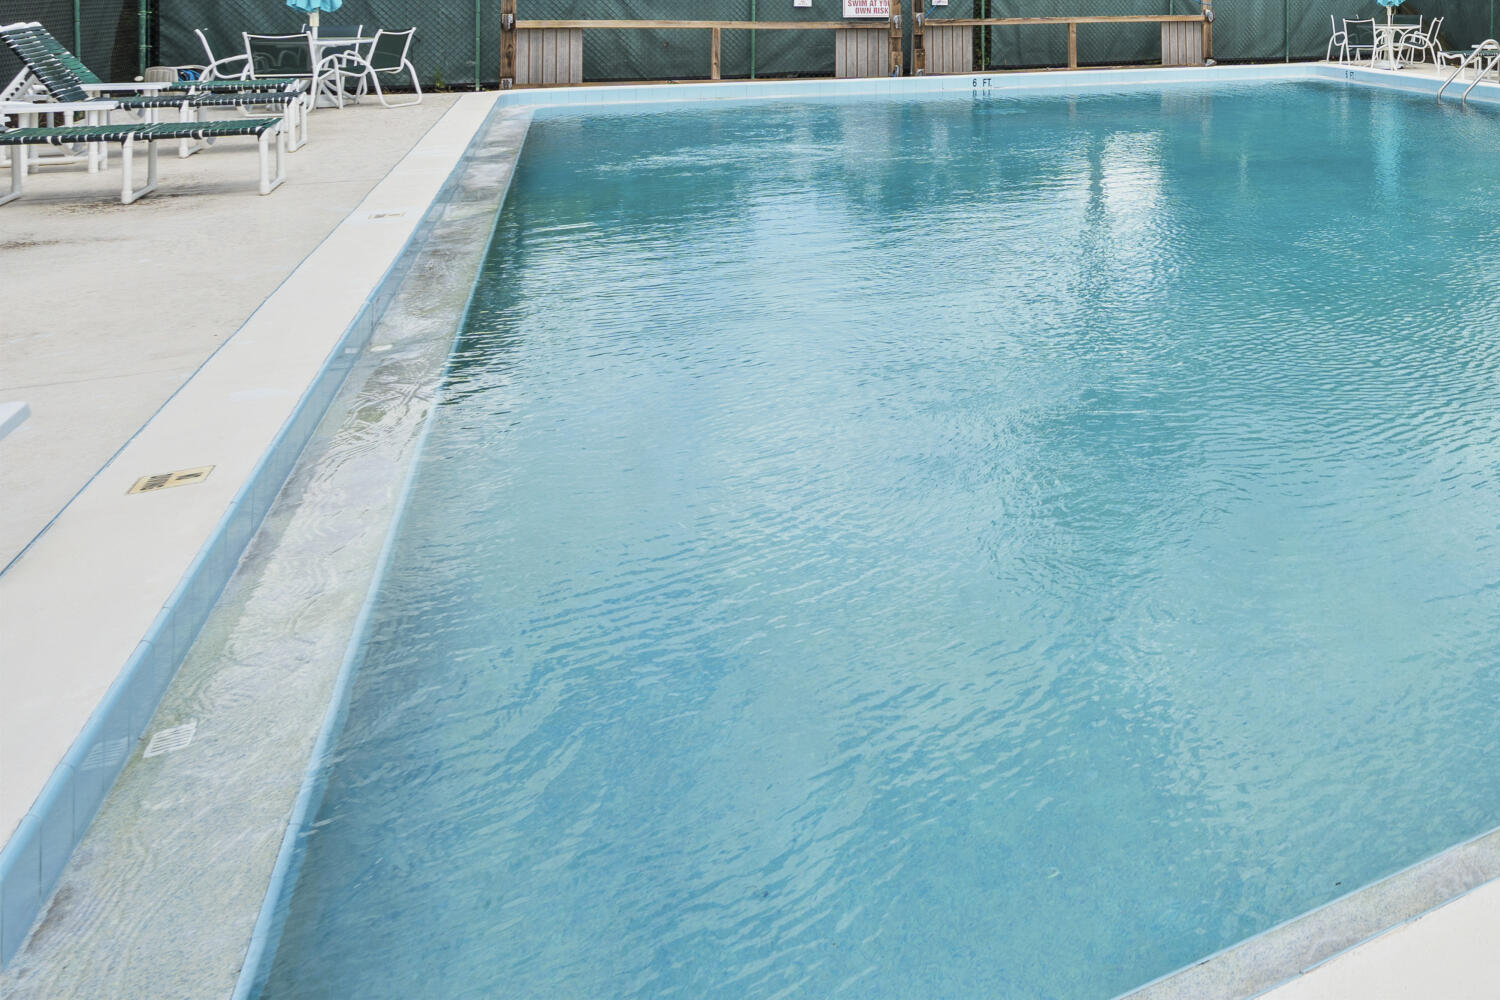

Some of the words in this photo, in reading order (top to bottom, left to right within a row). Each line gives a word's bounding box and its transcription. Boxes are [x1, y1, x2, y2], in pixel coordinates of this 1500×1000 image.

[847, 0, 867, 7] SWIM
[870, 0, 877, 7] AT
[972, 78, 977, 87] 6
